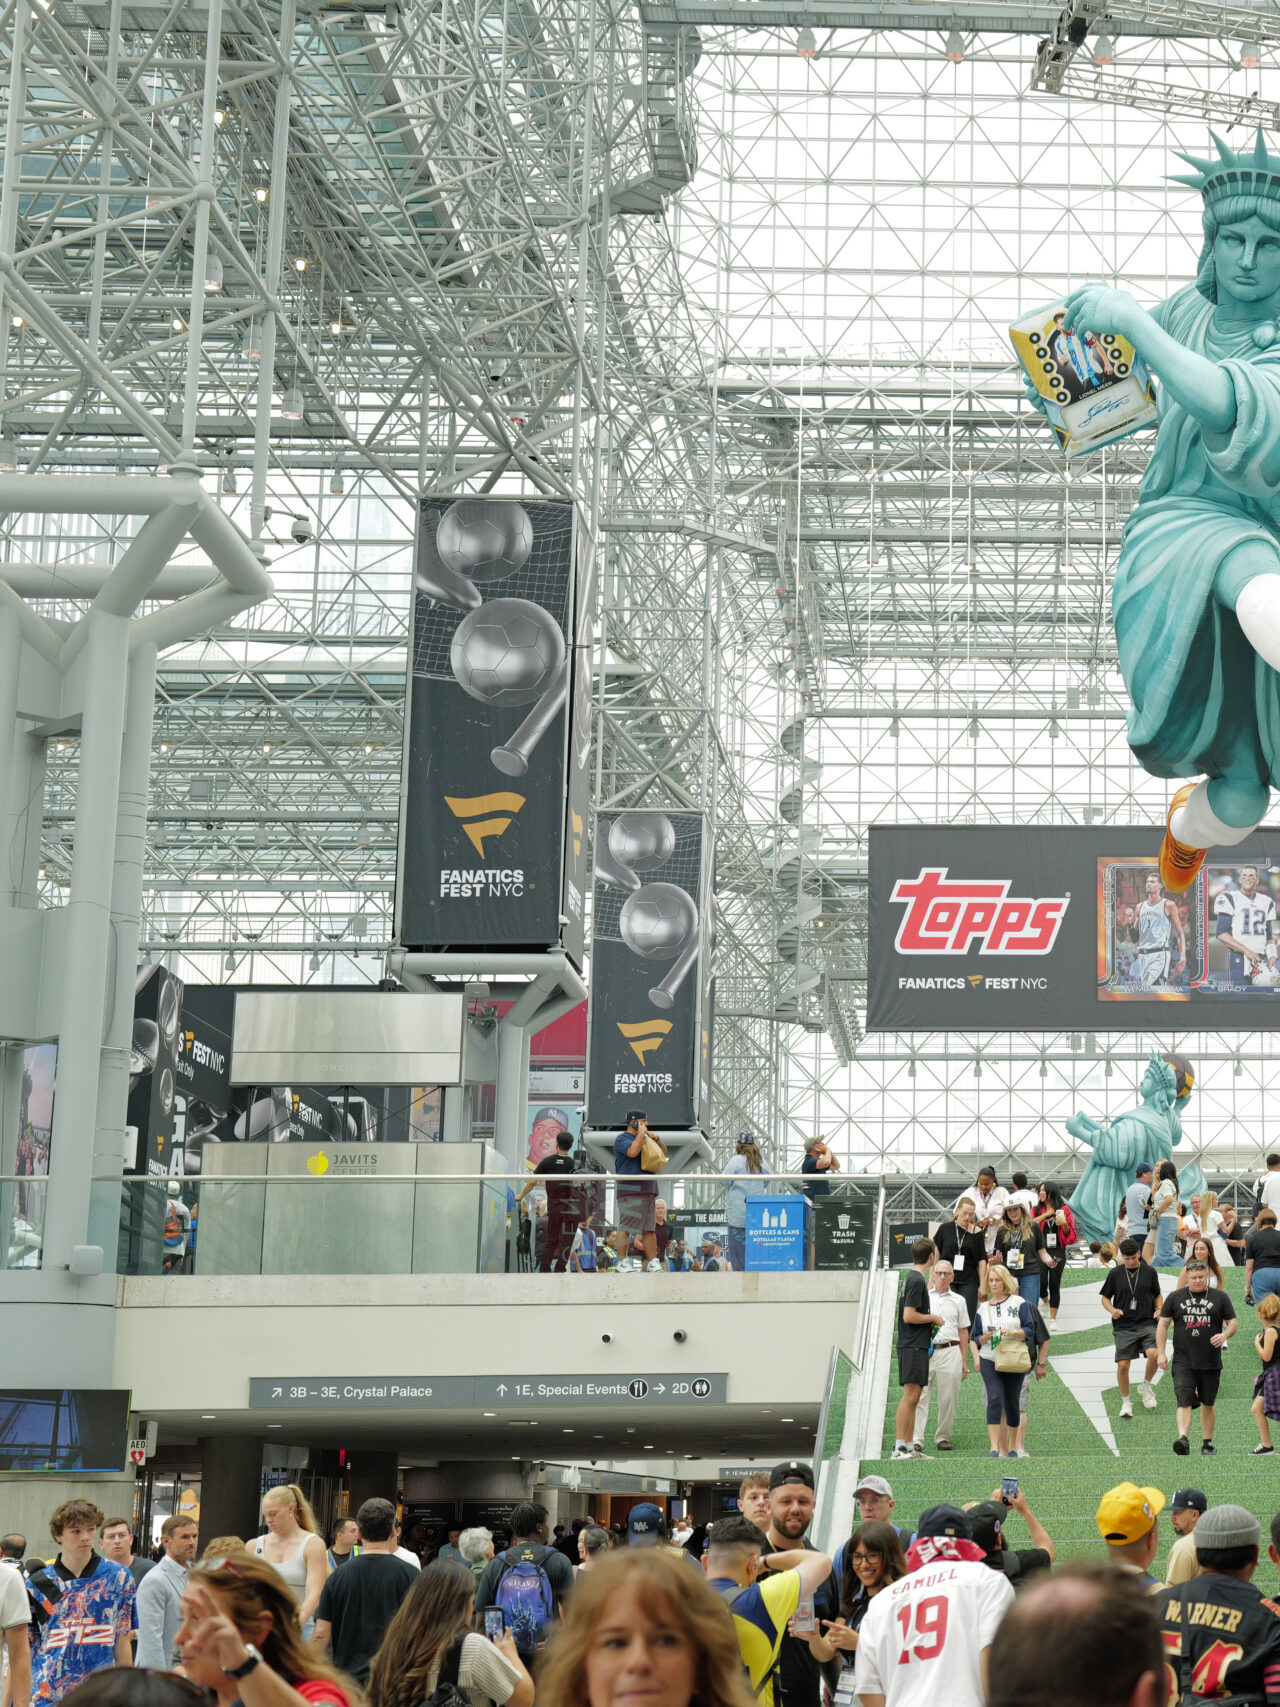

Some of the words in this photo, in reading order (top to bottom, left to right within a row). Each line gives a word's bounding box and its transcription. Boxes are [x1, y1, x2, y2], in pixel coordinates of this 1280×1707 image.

[440, 869, 524, 884] FANATICS
[440, 884, 484, 898] FEST
[488, 884, 524, 897] NYC
[1241, 907, 1266, 935] 12
[898, 977, 966, 990] FANATICS
[985, 977, 1018, 989] FEST
[1020, 977, 1048, 990] NYC
[192, 1040, 212, 1068] FEST
[209, 1051, 225, 1074] NYC
[574, 1079, 579, 1089] 8
[615, 1073, 673, 1084] FANATICS
[614, 1083, 645, 1093] FEST
[648, 1083, 673, 1093] NYC
[333, 1154, 378, 1165] JAVITS
[695, 1214, 707, 1223] THE
[708, 1213, 728, 1223] GAME
[1180, 1298, 1198, 1310] LET
[1200, 1299, 1214, 1310] ME
[289, 1386, 307, 1398] 3B
[320, 1386, 341, 1400] 3E,
[343, 1385, 386, 1400] Crystal
[392, 1385, 433, 1398] Palace
[514, 1385, 534, 1398] 1E,
[537, 1384, 581, 1398] Special
[586, 1383, 628, 1396] Events
[671, 1383, 690, 1395] 2D
[130, 1440, 146, 1450] AED
[507, 1577, 540, 1590] WAKANDA
[891, 1568, 958, 1600] SAMUEL
[63, 1617, 96, 1625] THE
[896, 1595, 949, 1665] 19
[48, 1624, 115, 1650] 212
